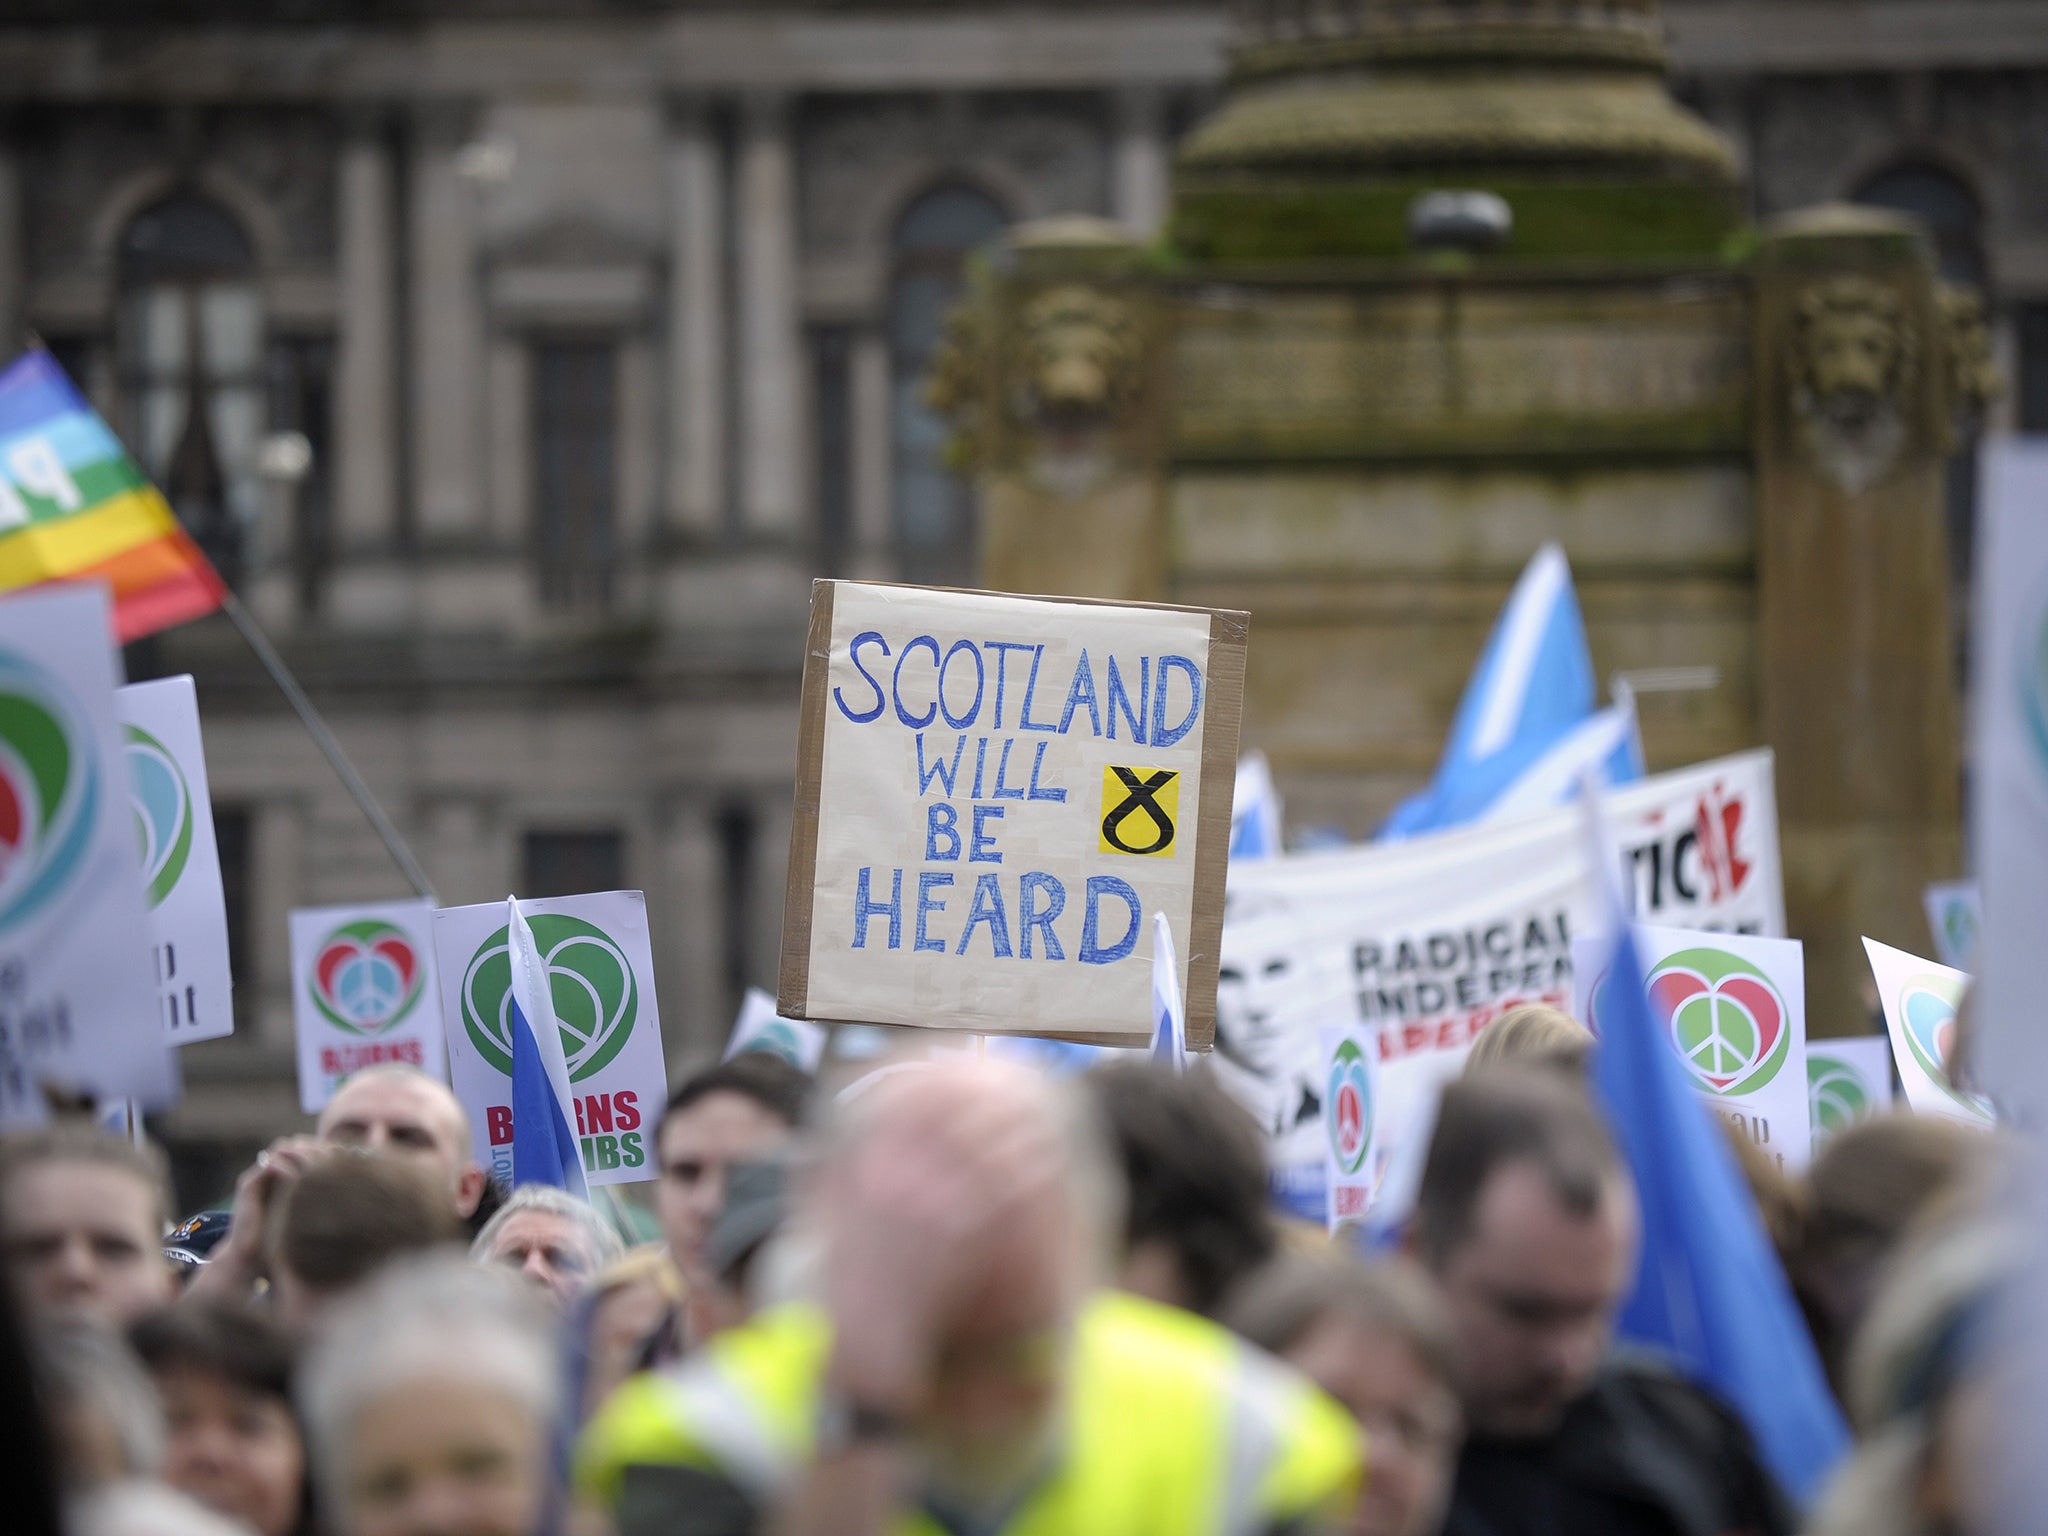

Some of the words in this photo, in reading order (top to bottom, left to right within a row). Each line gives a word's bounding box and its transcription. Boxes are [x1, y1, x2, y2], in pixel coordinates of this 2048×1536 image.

[833, 631, 1204, 748] SCOTLAND
[915, 733, 1068, 804] WILL
[925, 803, 1005, 864] BE
[851, 866, 1142, 965] HEARD
